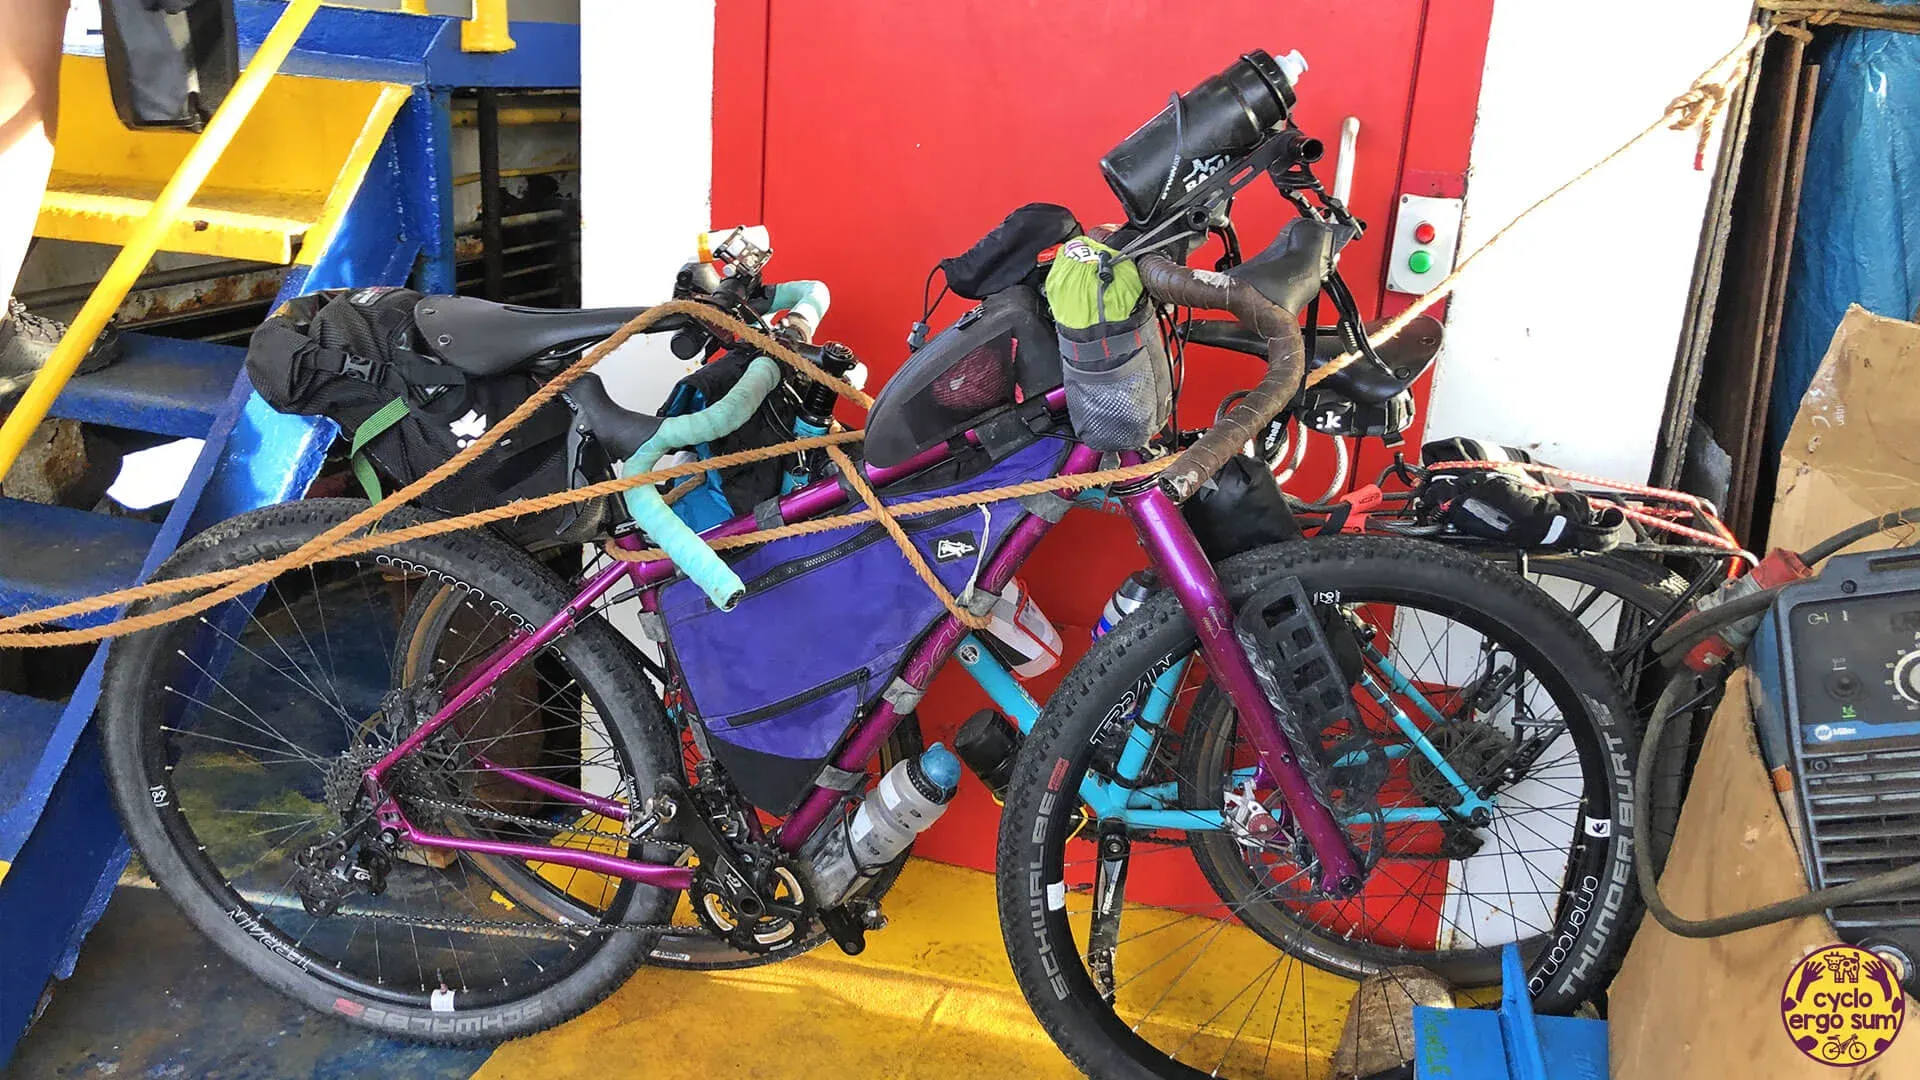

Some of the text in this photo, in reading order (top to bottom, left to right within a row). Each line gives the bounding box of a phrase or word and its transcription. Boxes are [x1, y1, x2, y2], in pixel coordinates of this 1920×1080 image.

[376, 554, 485, 602] american
[1029, 791, 1071, 1001] SCHWALBE
[1557, 834, 1635, 997] THUNDER
[1602, 731, 1635, 828] BURT
[1541, 874, 1600, 977] american
[363, 1000, 544, 1034] SCHWALBE
